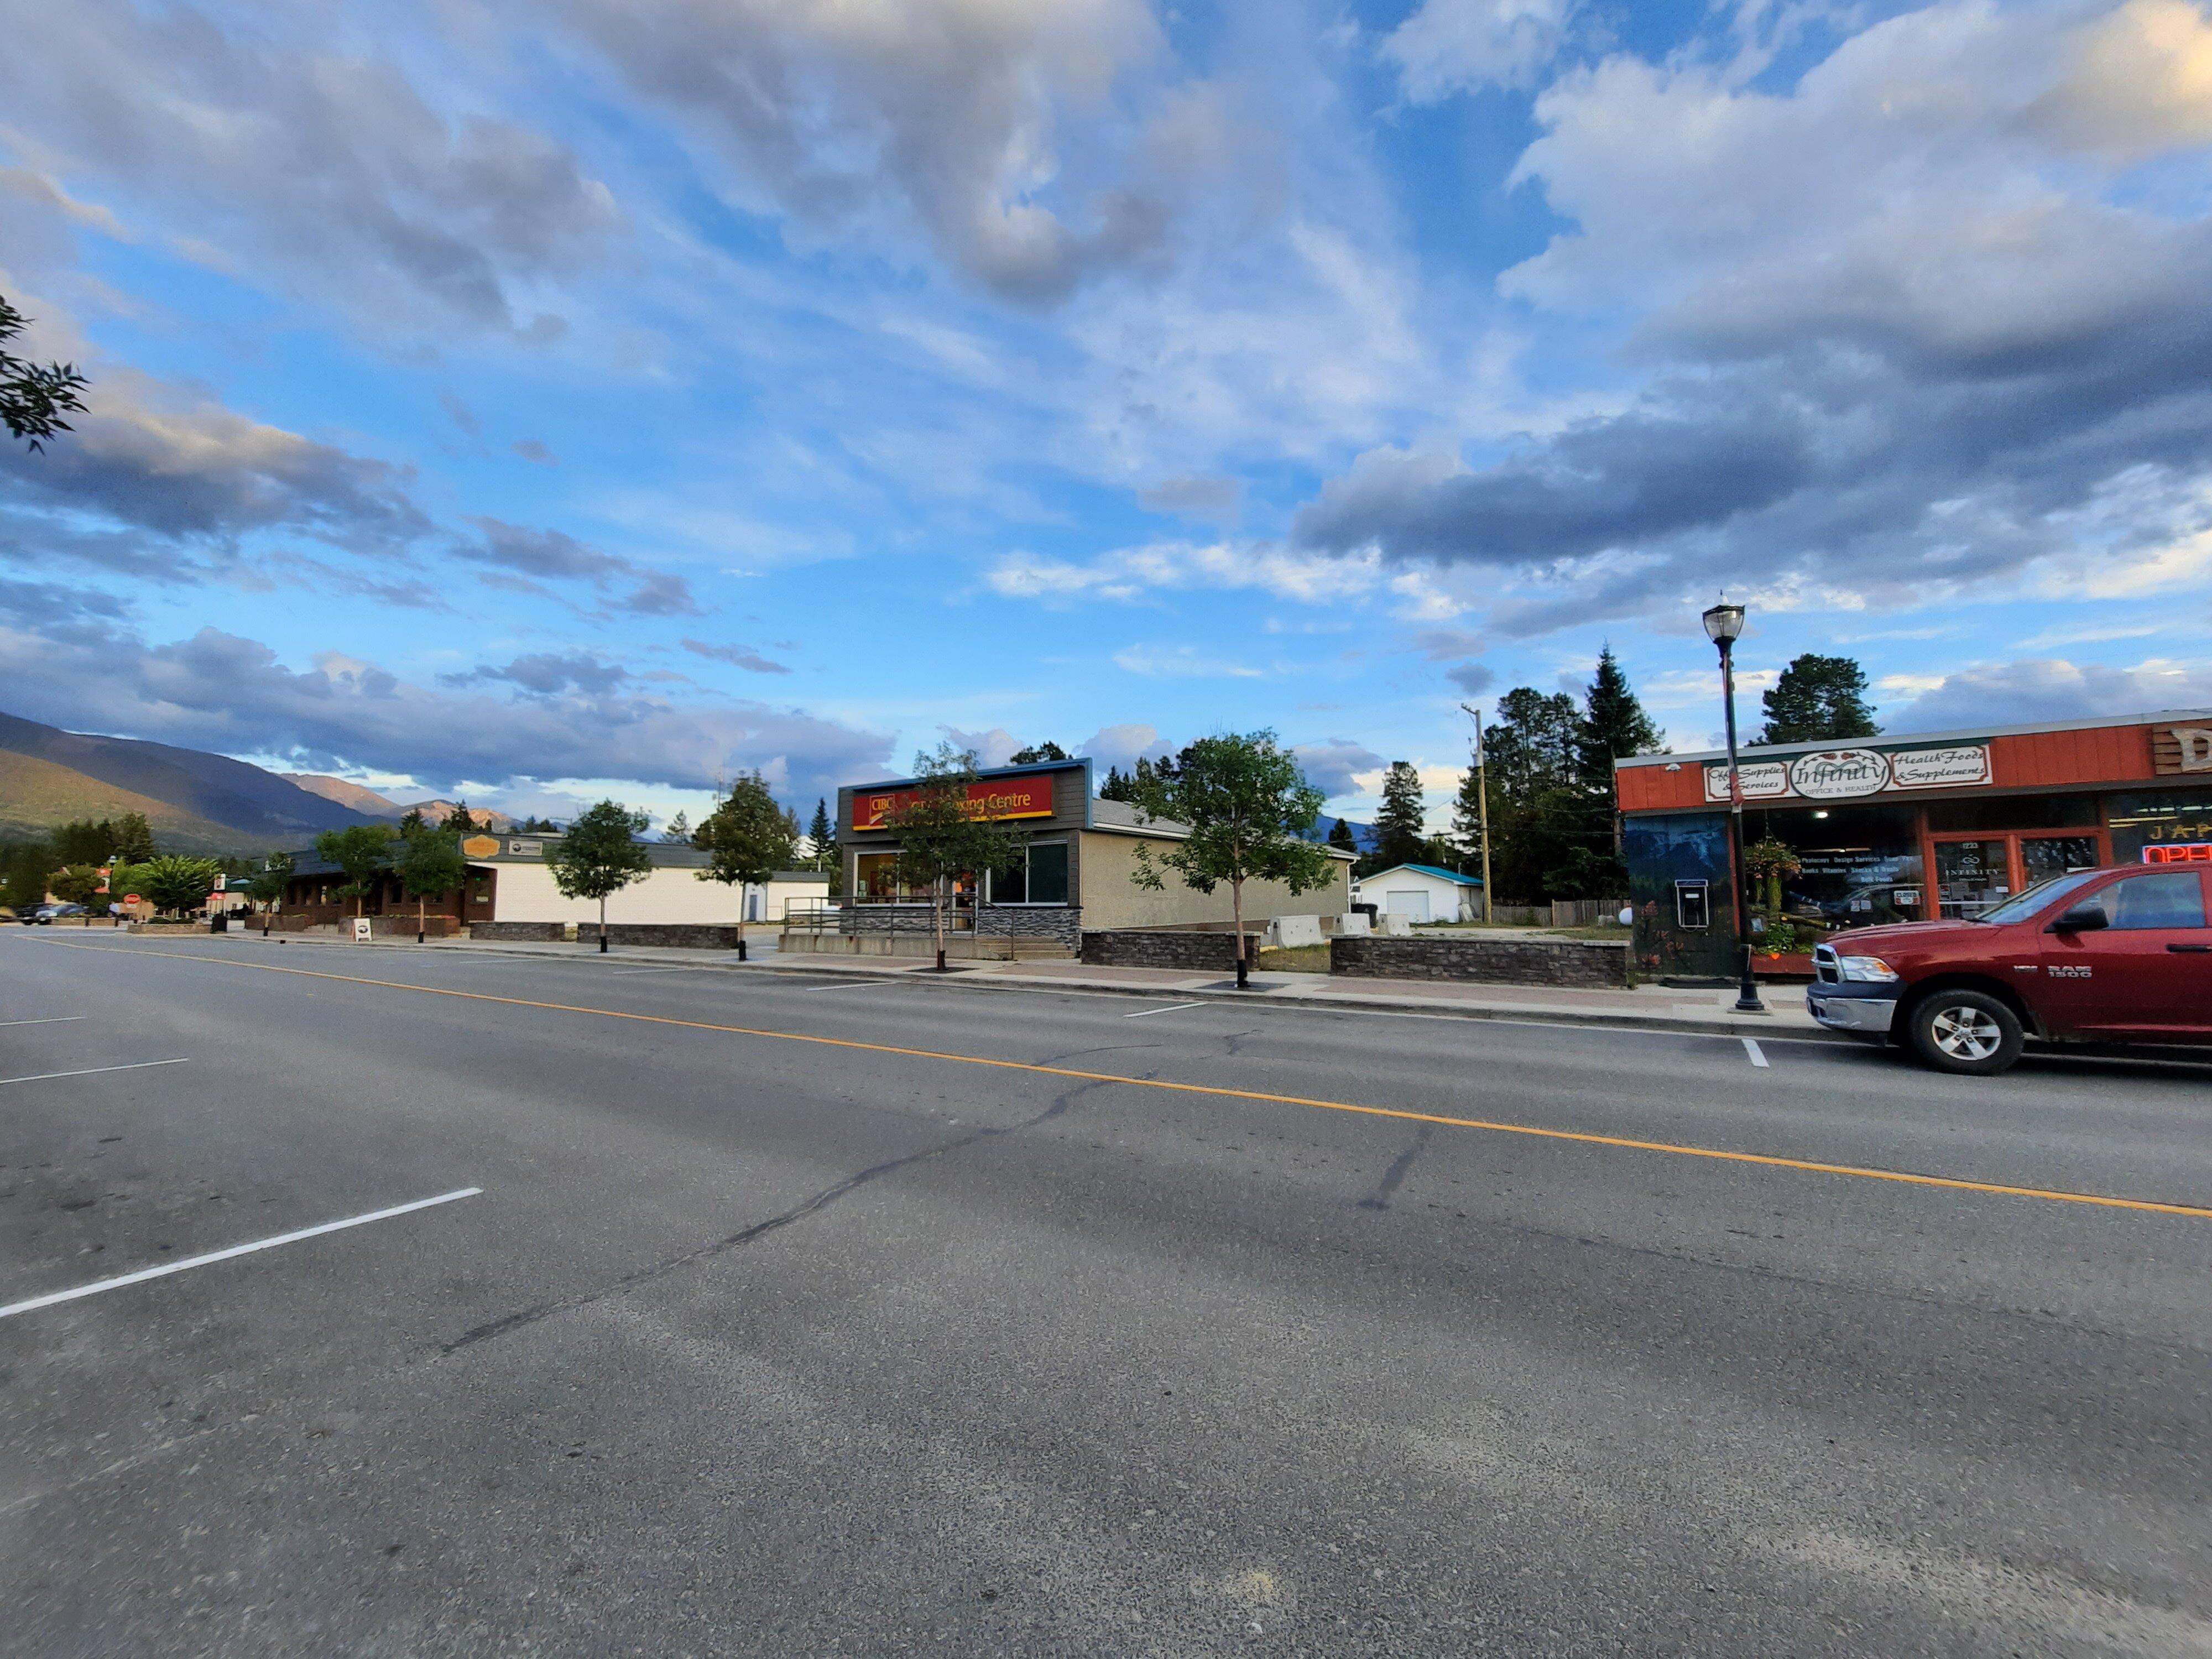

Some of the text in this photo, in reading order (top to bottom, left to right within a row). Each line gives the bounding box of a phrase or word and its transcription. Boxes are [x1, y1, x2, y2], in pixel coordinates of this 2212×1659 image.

[1894, 750, 1984, 765] Health Foods
[1738, 767, 1785, 779] Supplies
[1795, 764, 1886, 788] Infinity
[1905, 767, 1984, 781] Supplements
[1739, 781, 1778, 790] Services
[872, 797, 893, 811] CIBC
[989, 793, 1031, 809] Centre
[2146, 846, 2212, 863] OPE
